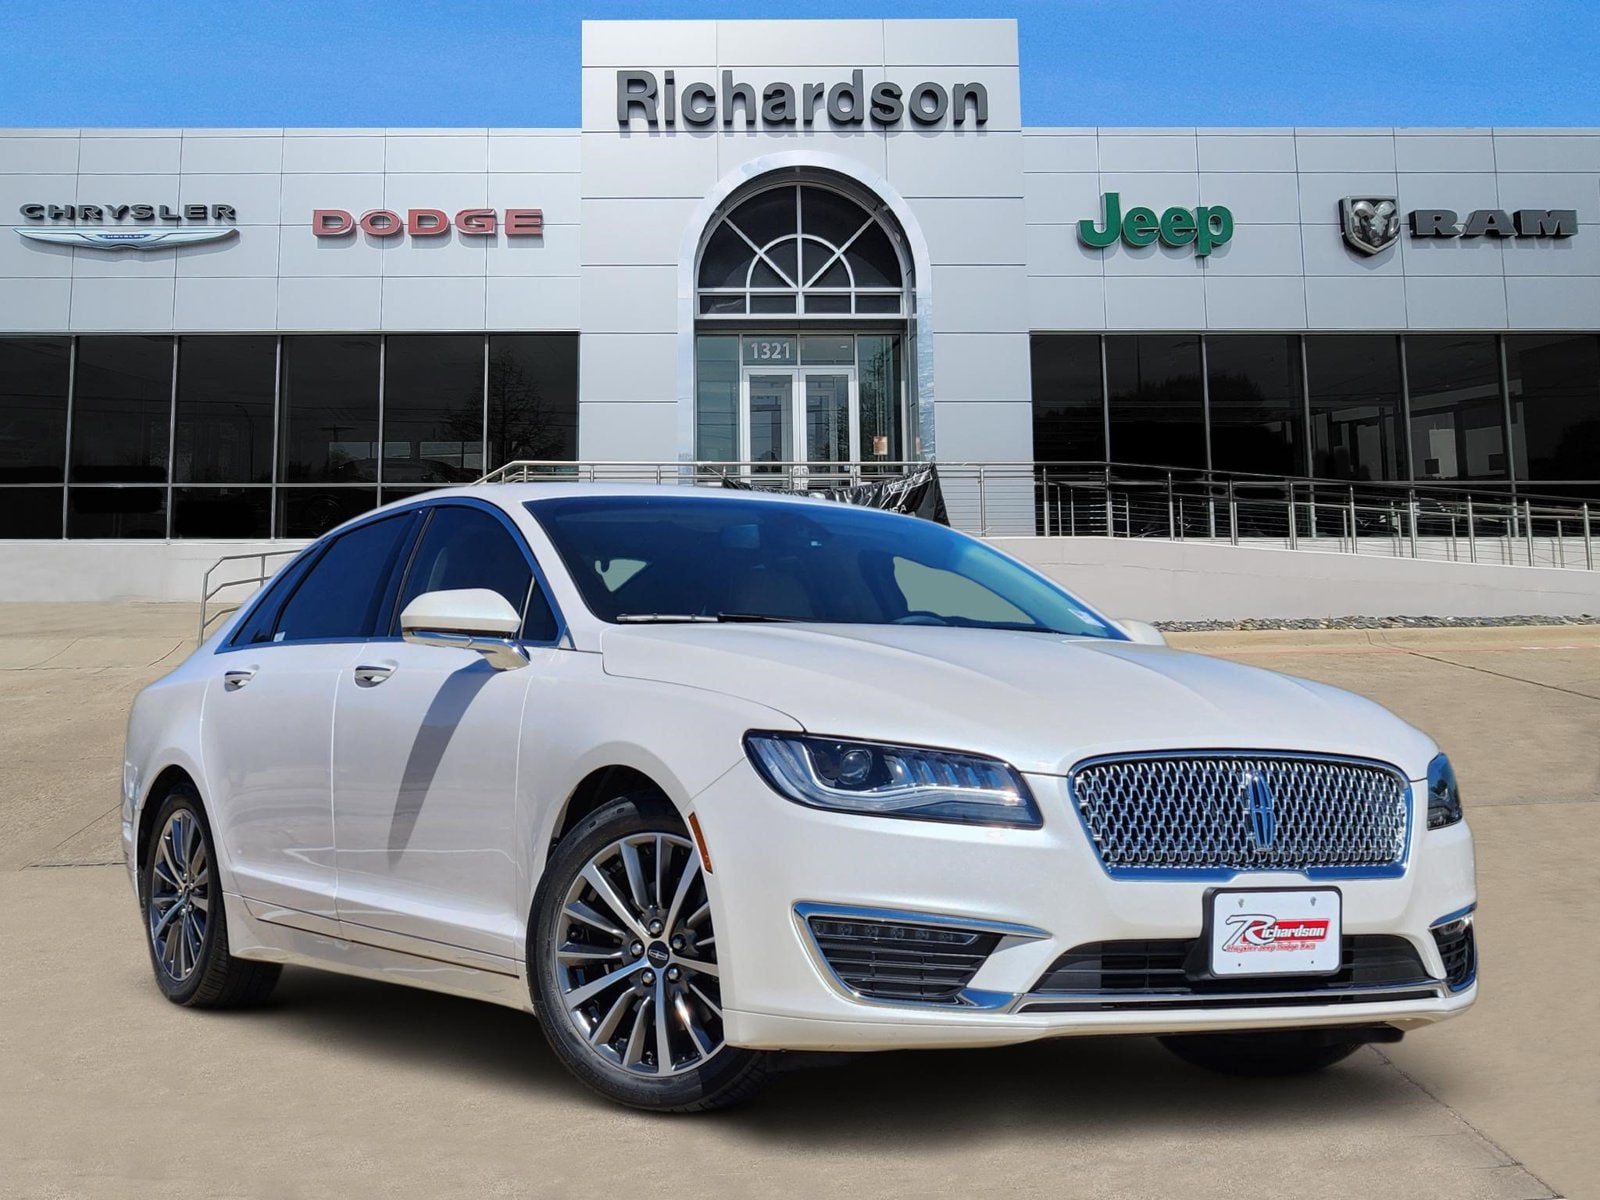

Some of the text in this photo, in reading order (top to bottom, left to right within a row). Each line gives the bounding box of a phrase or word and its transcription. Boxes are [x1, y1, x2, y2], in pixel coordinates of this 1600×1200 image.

[616, 69, 988, 127] Richardson
[19, 203, 237, 221] CHRYSLER
[312, 208, 544, 236] DODGE
[1078, 192, 1234, 257] Jeep
[1408, 209, 1578, 238] RAM
[751, 342, 791, 359] 1321
[1222, 913, 1326, 951] Richardson
